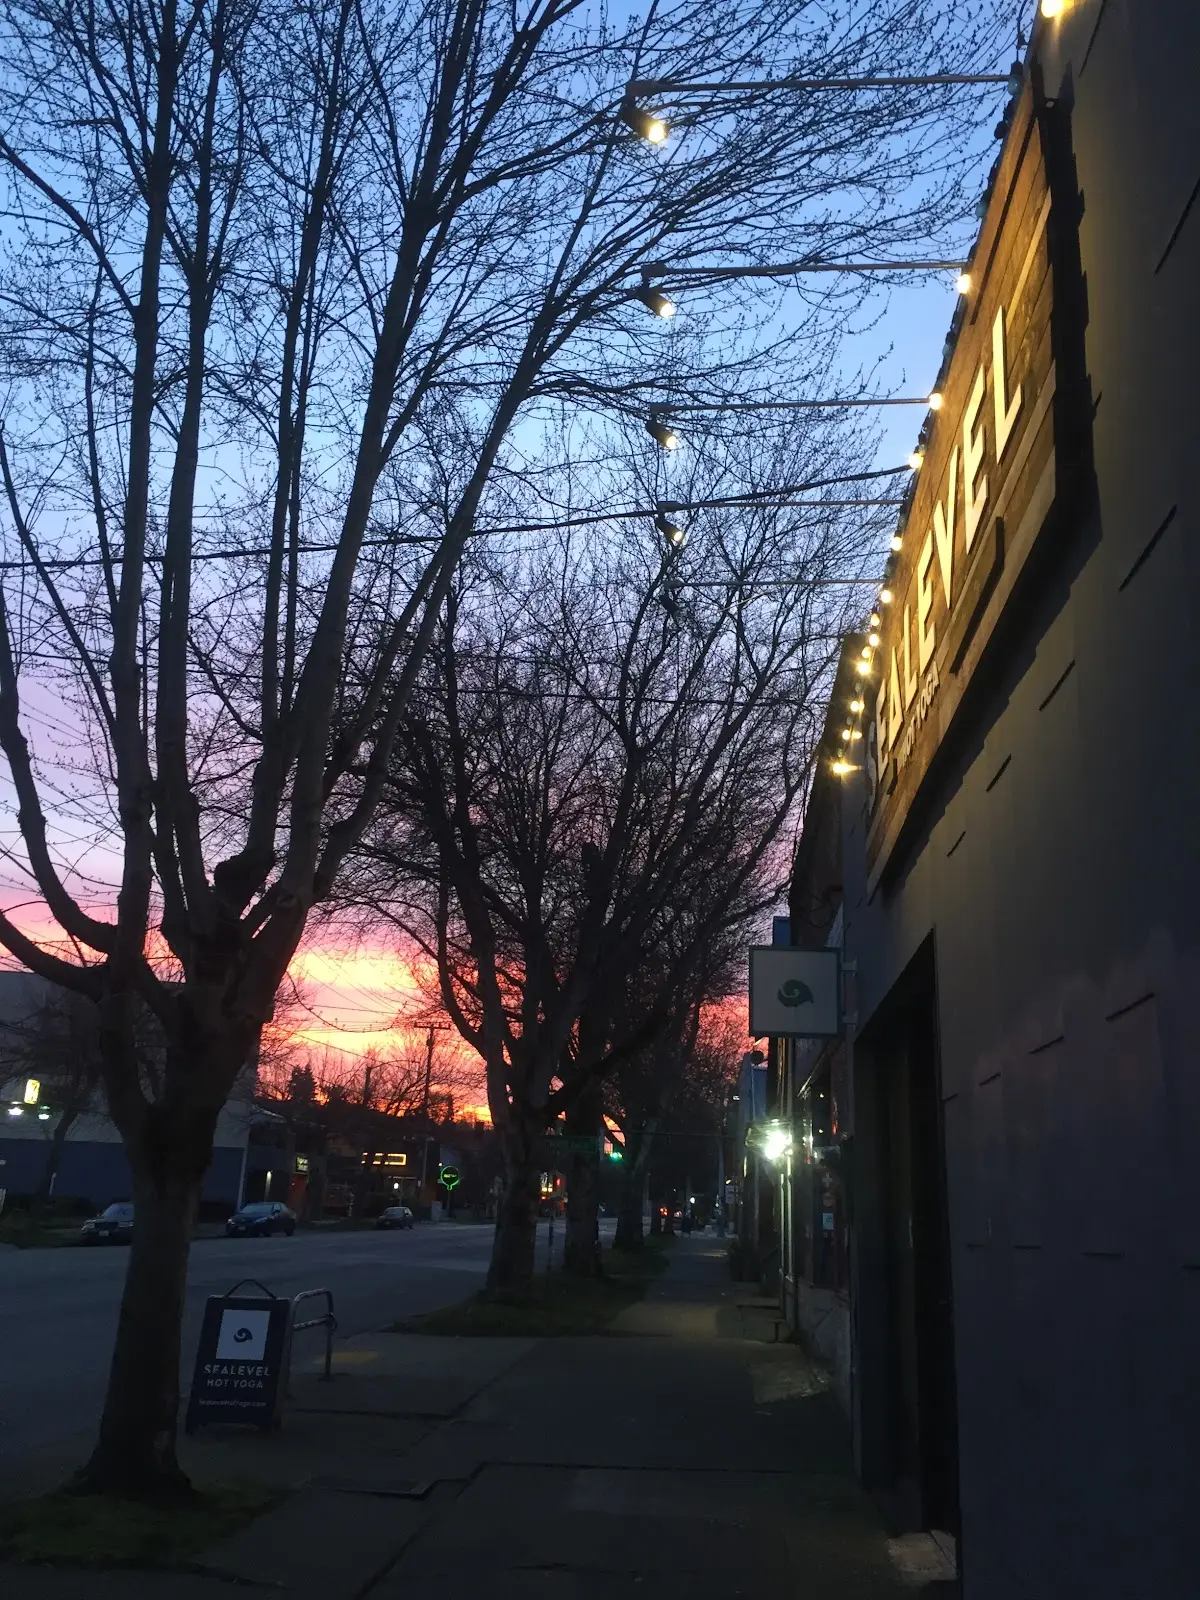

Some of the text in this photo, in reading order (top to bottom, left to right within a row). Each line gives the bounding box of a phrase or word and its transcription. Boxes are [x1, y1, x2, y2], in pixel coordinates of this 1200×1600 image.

[867, 305, 1024, 816] SEALEVEL
[915, 661, 941, 730] YOGA
[203, 1364, 271, 1376] SEALEVEL
[207, 1378, 264, 1389] HOT YOGA
